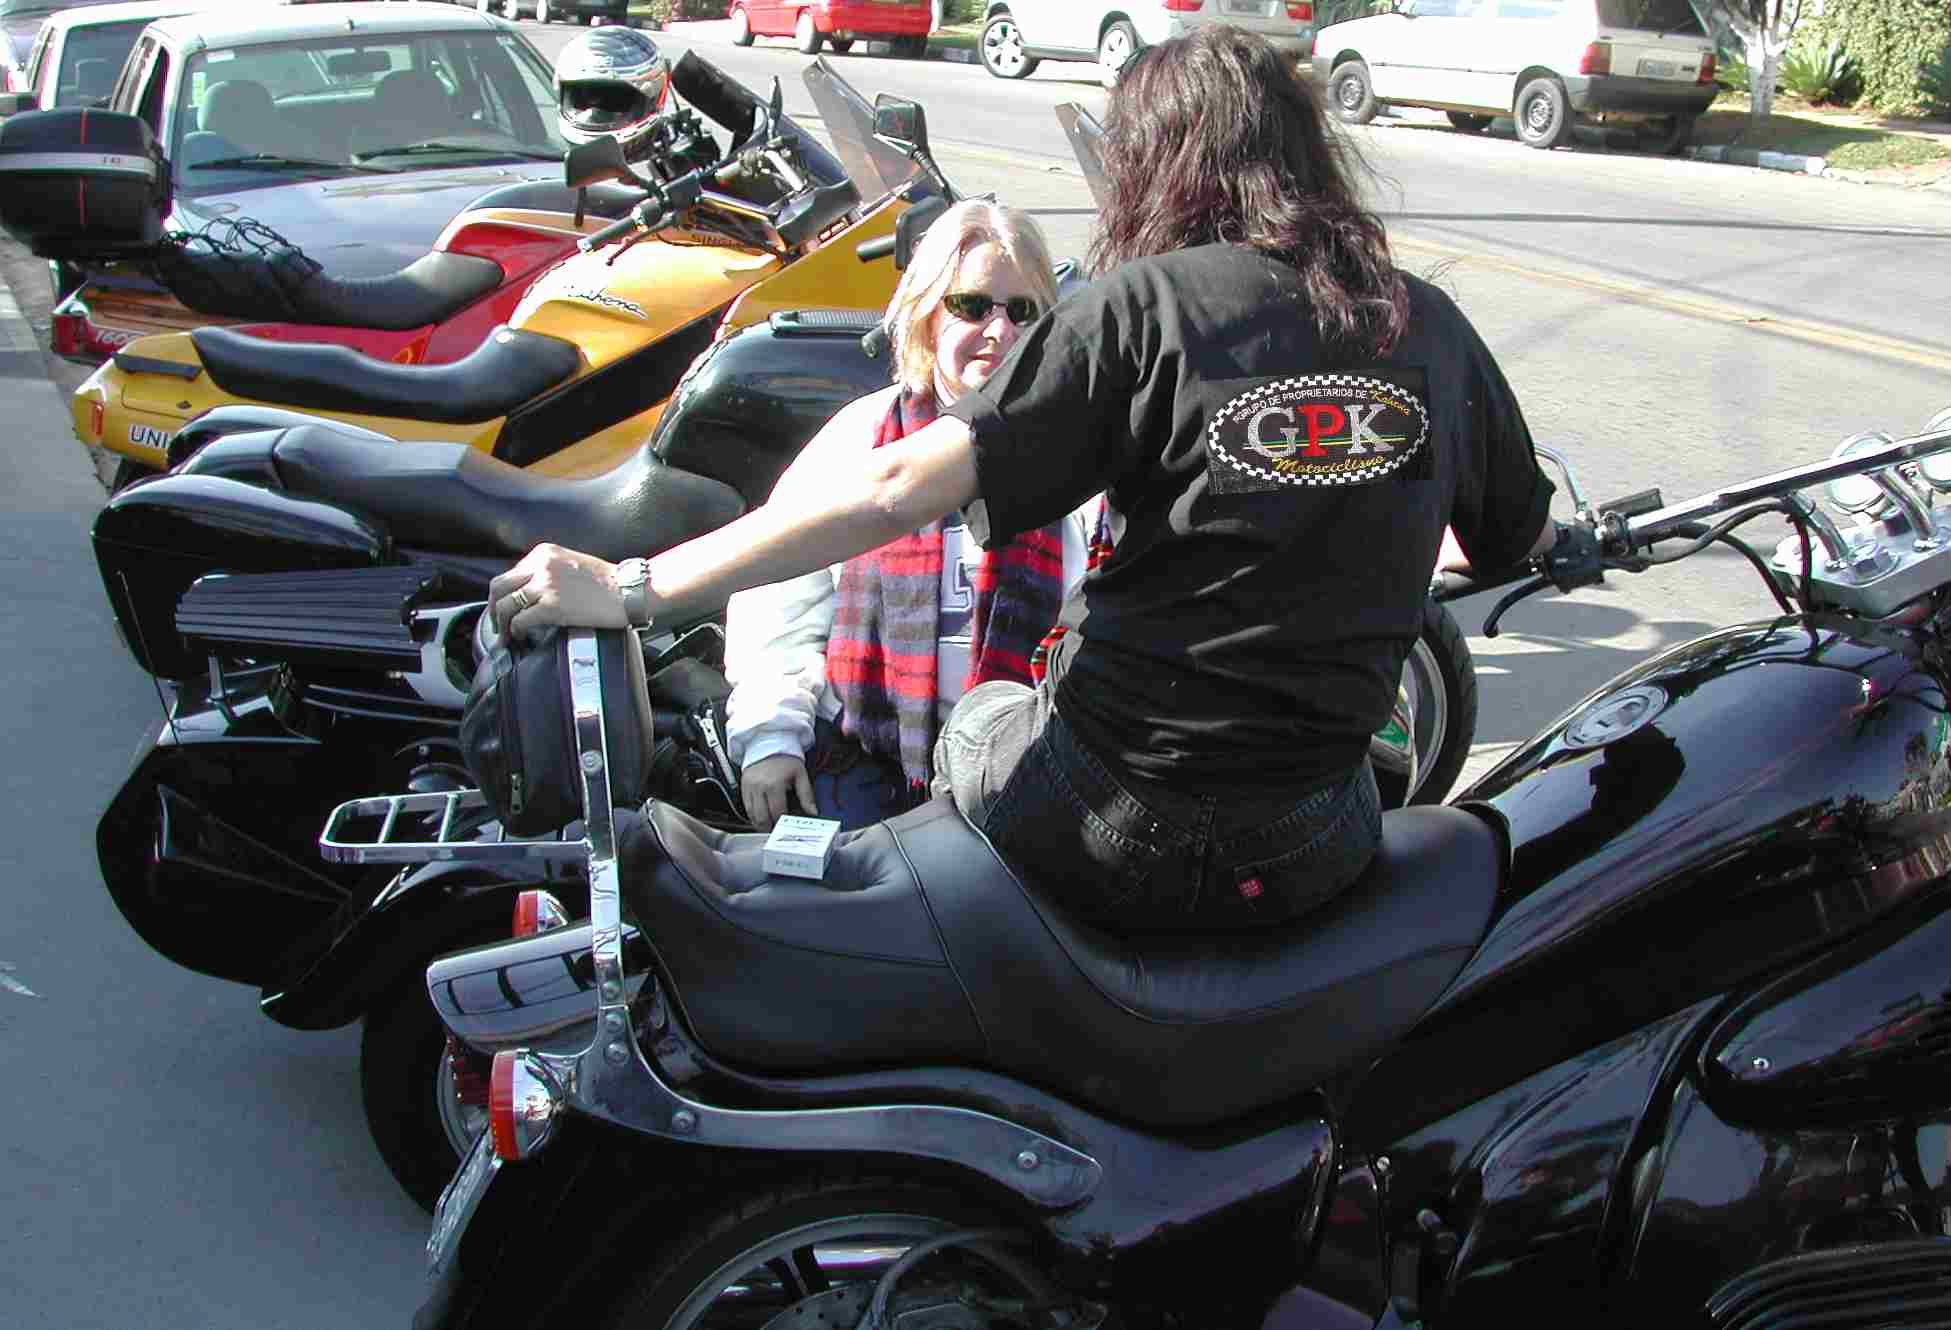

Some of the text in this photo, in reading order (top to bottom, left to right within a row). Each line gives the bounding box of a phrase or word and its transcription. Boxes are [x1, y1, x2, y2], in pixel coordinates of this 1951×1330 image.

[1268, 395, 1282, 407] DE
[1283, 387, 1353, 401] PROPRIETARIOS
[1355, 389, 1368, 399] DE
[1247, 403, 1394, 457] GPK
